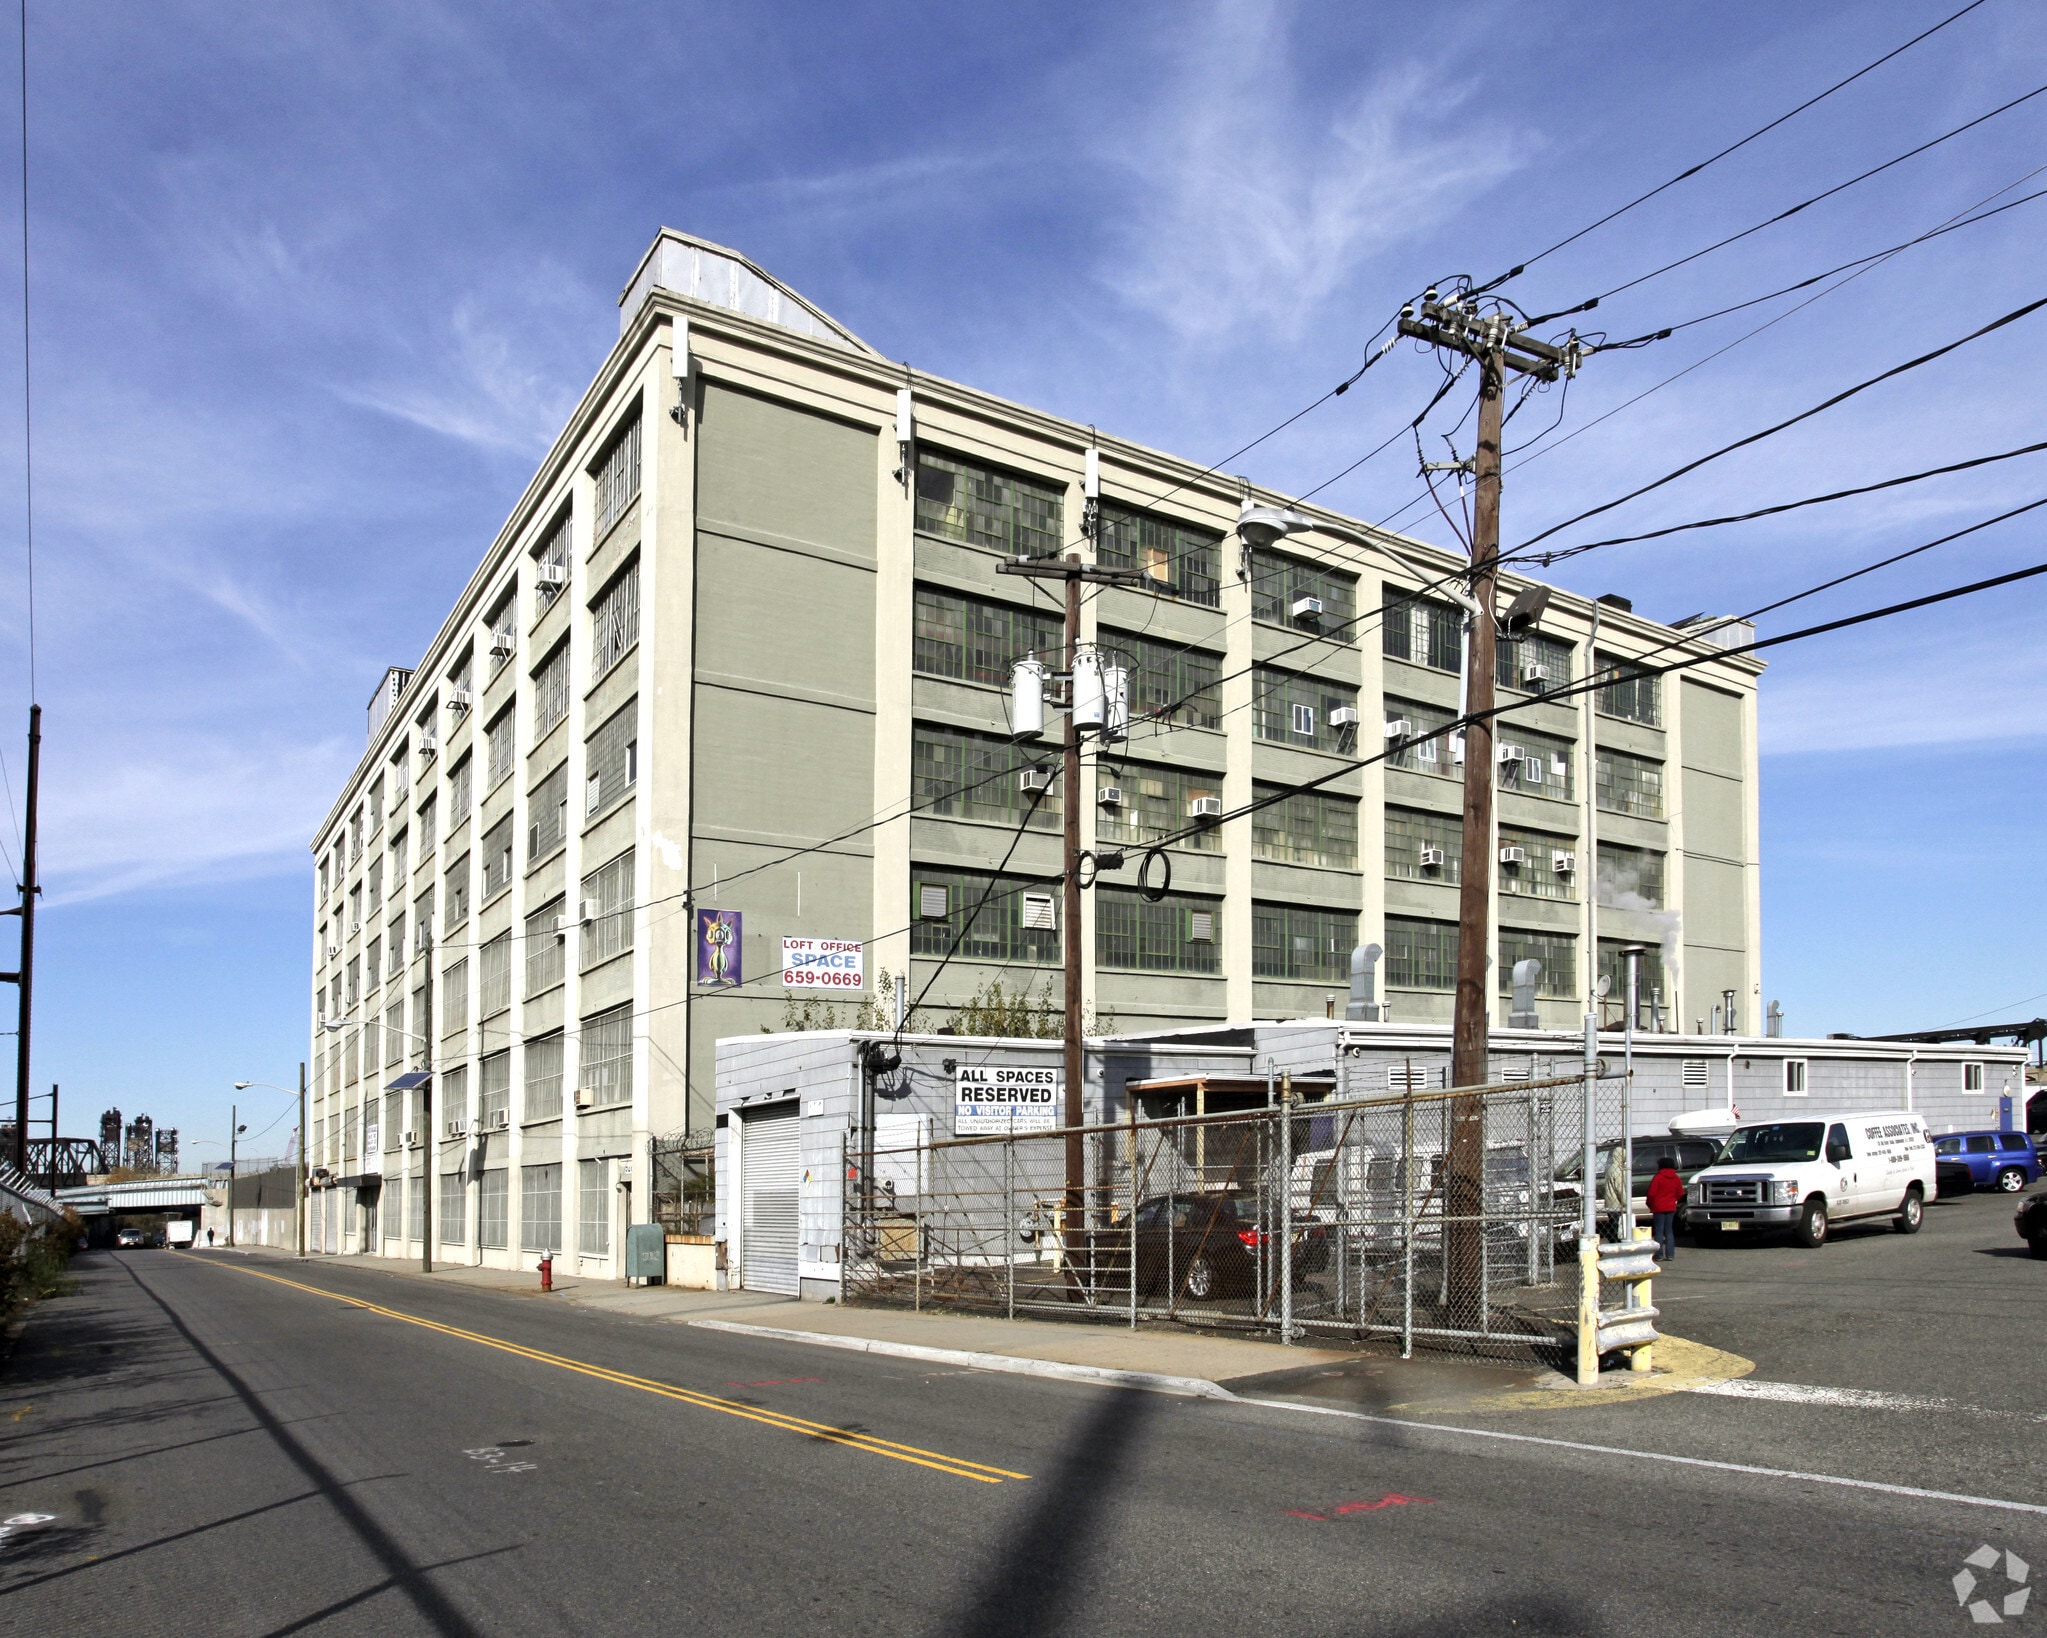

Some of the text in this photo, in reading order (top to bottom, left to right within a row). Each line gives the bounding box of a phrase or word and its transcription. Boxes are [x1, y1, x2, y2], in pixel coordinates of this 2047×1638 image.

[783, 939, 862, 953] LOFT OFFICE
[791, 952, 856, 969] SPACE
[784, 970, 862, 986] 659-0669
[960, 1069, 1054, 1083] ALL SPACES
[961, 1087, 1052, 1103] RESERVED
[958, 1105, 1055, 1116] NO VISITOR PARKING
[1865, 1126, 1883, 1140] COFFEE
